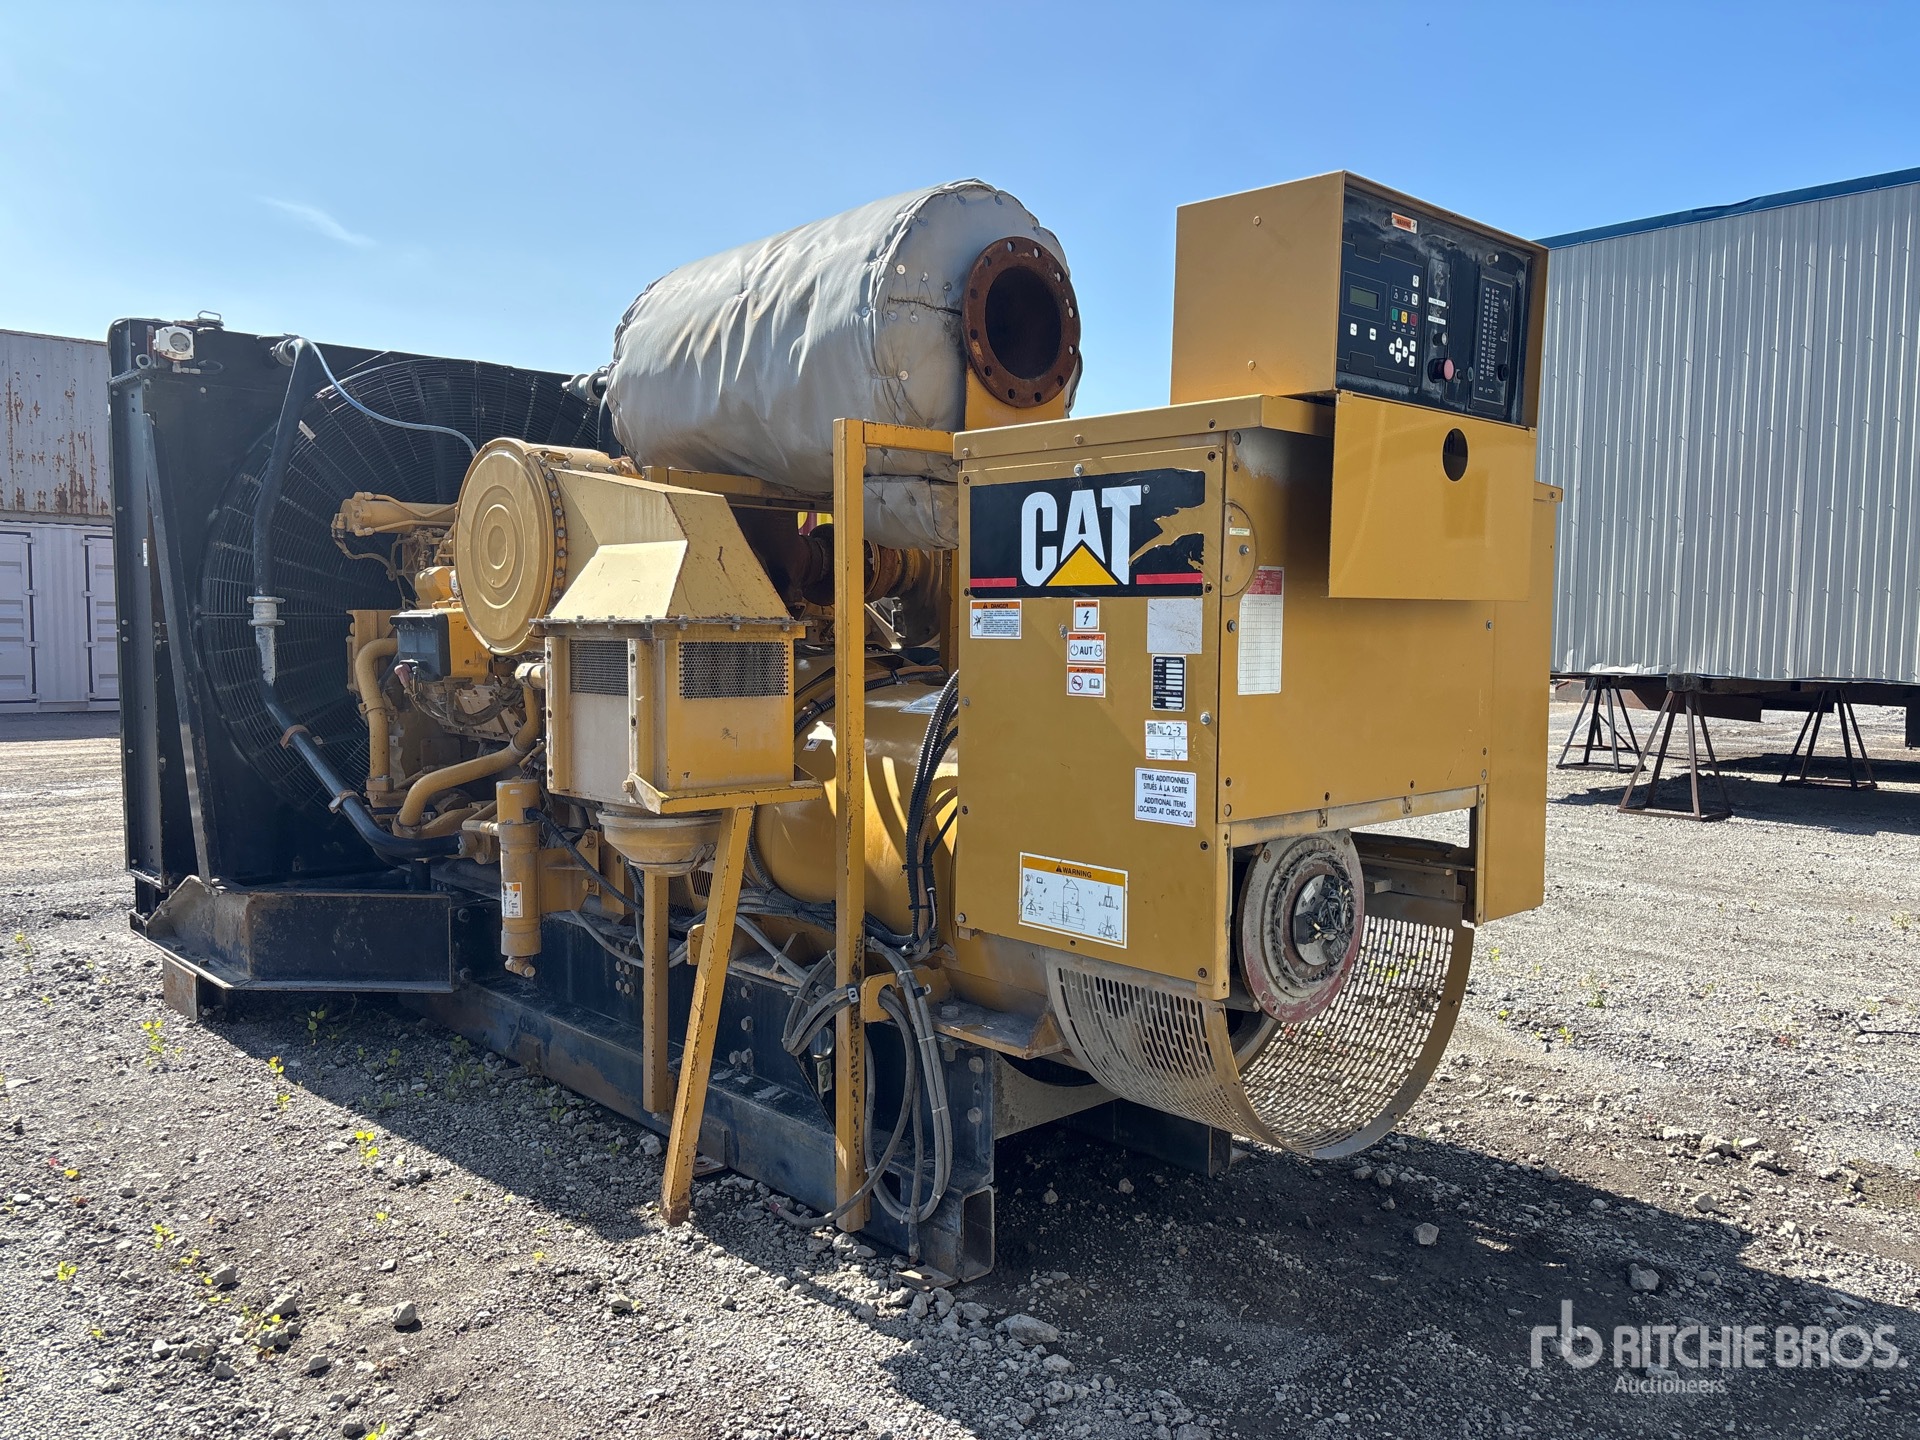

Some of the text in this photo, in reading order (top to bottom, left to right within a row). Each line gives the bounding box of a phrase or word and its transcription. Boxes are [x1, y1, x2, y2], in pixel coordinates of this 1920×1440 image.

[1021, 485, 1142, 587] CAT
[1079, 646, 1093, 655] AUT
[1141, 773, 1189, 785] ITEMS ADDITIONNELS
[1143, 782, 1157, 791] SITUÉS
[1172, 786, 1188, 794] SORTIE
[1144, 797, 1187, 808] ADDITIONAL ITEMS
[1138, 805, 1157, 814] LOCATED
[1166, 809, 1193, 818] CHECK-OUT
[1062, 867, 1092, 878] WARNING
